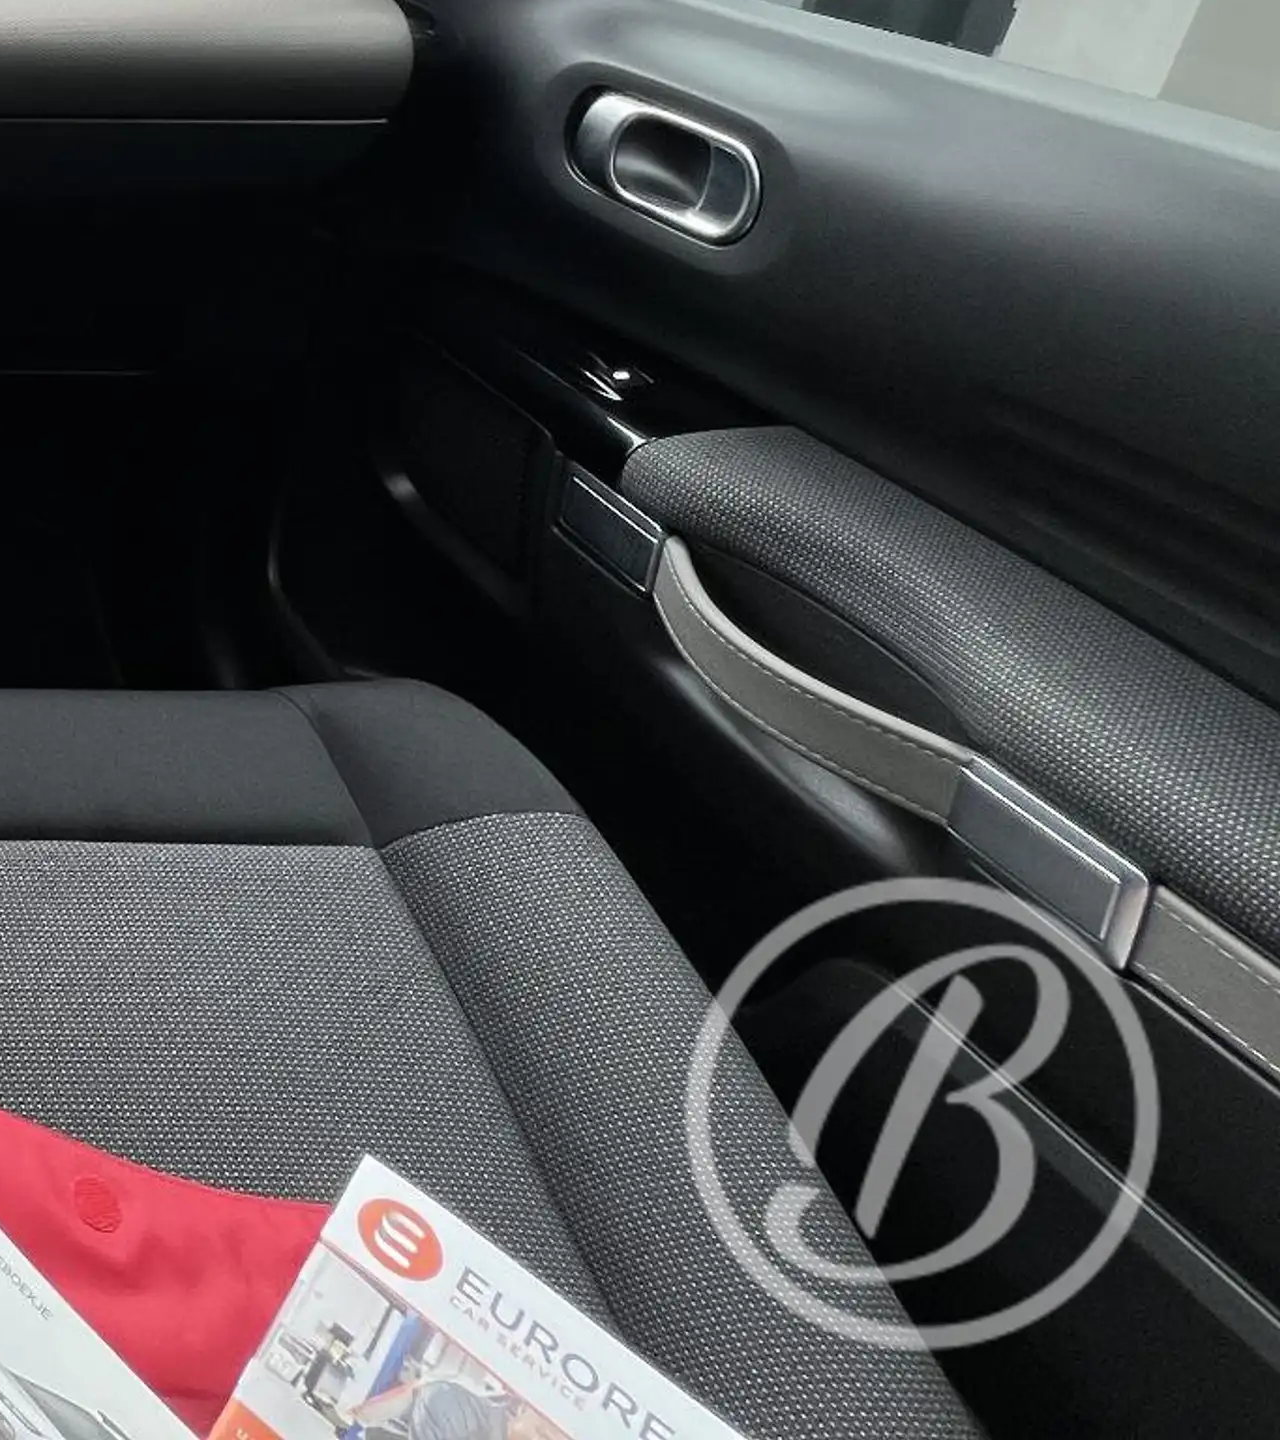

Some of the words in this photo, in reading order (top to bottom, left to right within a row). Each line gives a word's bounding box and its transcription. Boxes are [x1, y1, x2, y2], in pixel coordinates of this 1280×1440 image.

[448, 1294, 490, 1332] CAR
[495, 1332, 588, 1411] SERVICE
[455, 1266, 676, 1440] EURORE
